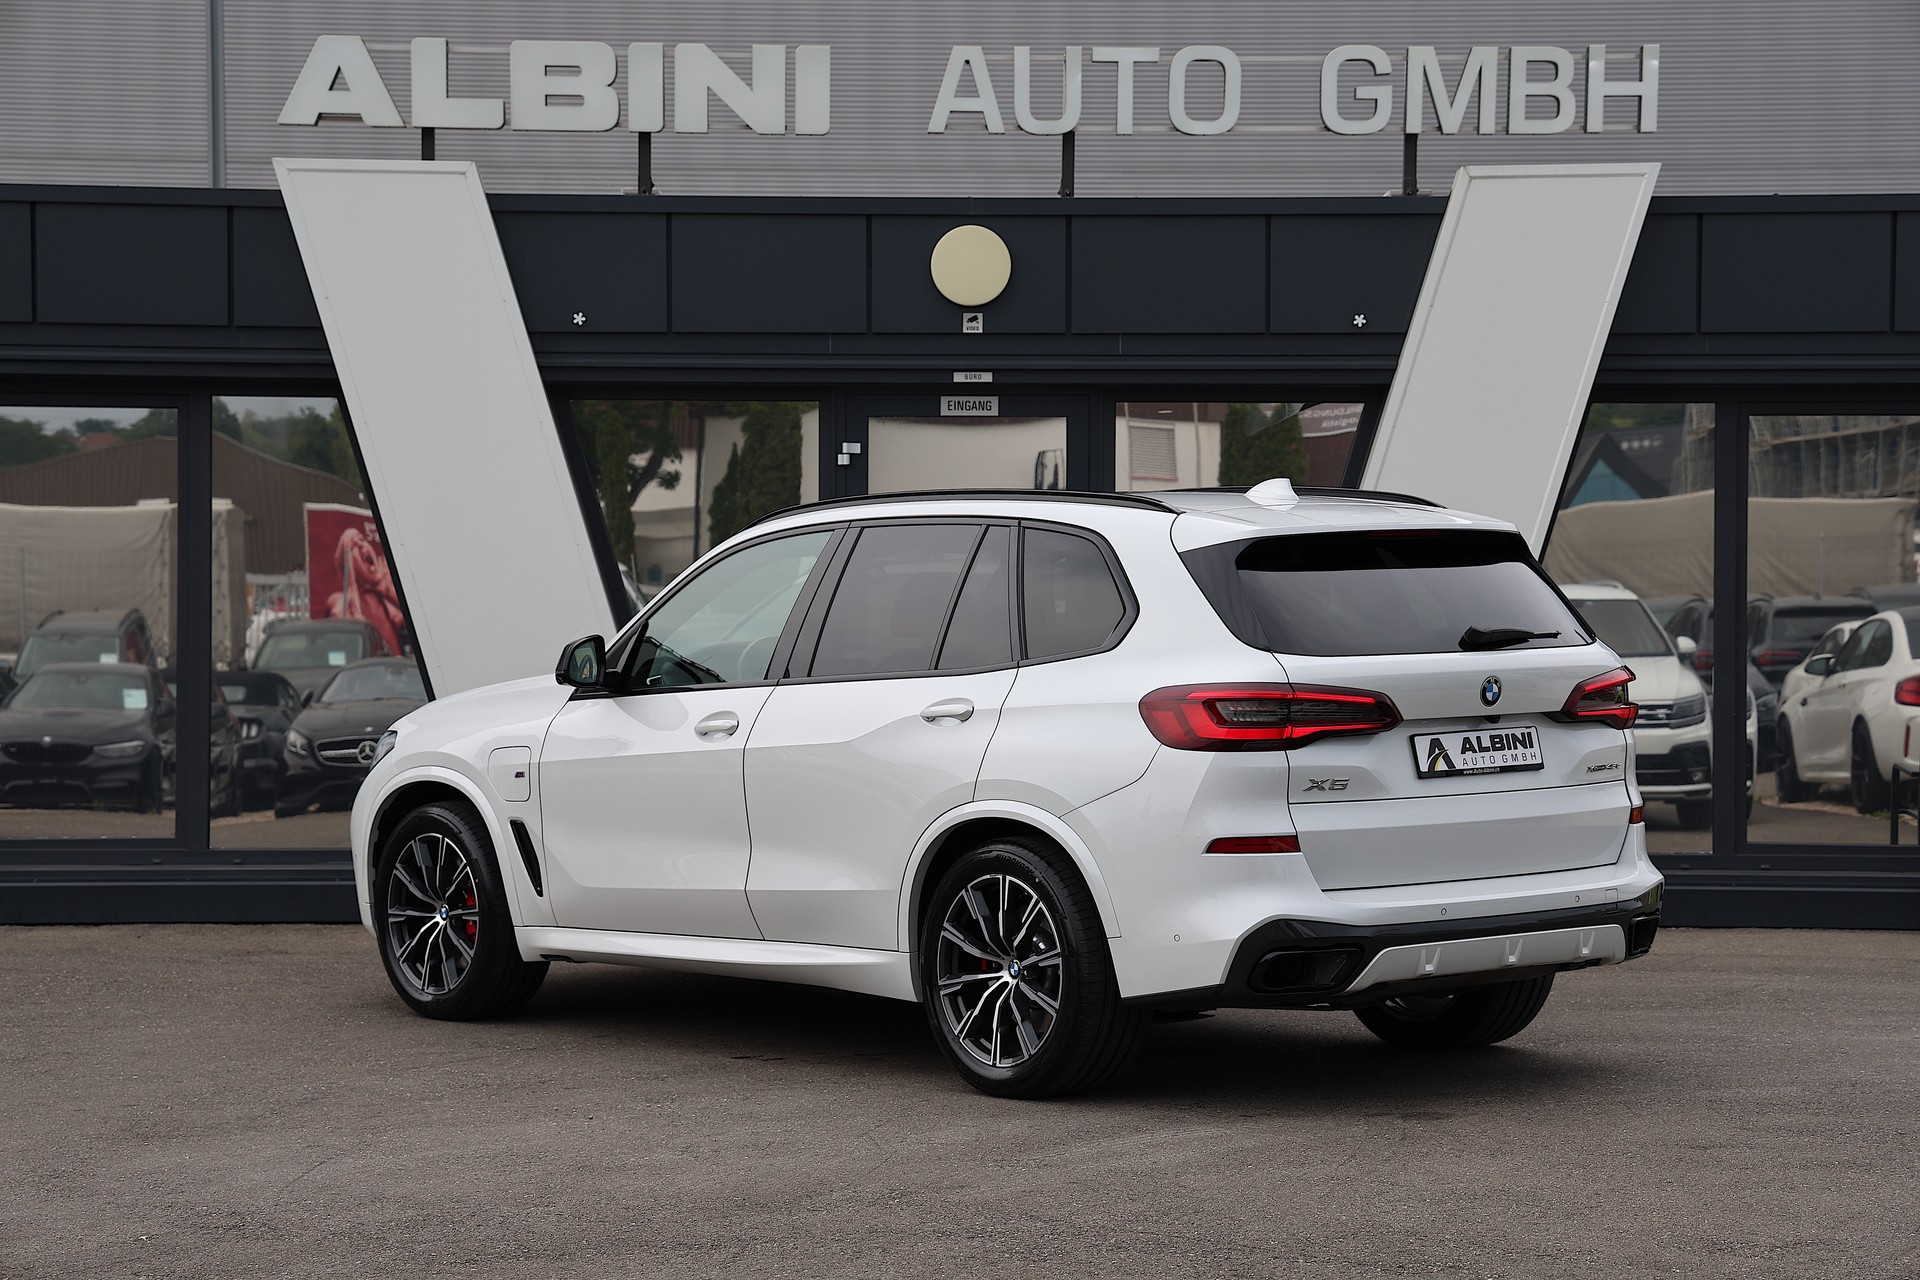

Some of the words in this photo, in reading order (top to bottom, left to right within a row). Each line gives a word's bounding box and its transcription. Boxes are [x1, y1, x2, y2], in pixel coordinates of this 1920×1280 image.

[277, 34, 832, 136] ALBINI
[927, 45, 1242, 136] AUTO
[1320, 44, 1661, 136] GMBH
[947, 400, 992, 411] EINGANG
[1461, 732, 1534, 754] ALBINI
[1462, 756, 1496, 767] AUTO
[1501, 752, 1537, 763] GMBH
[1301, 778, 1350, 791] X5
